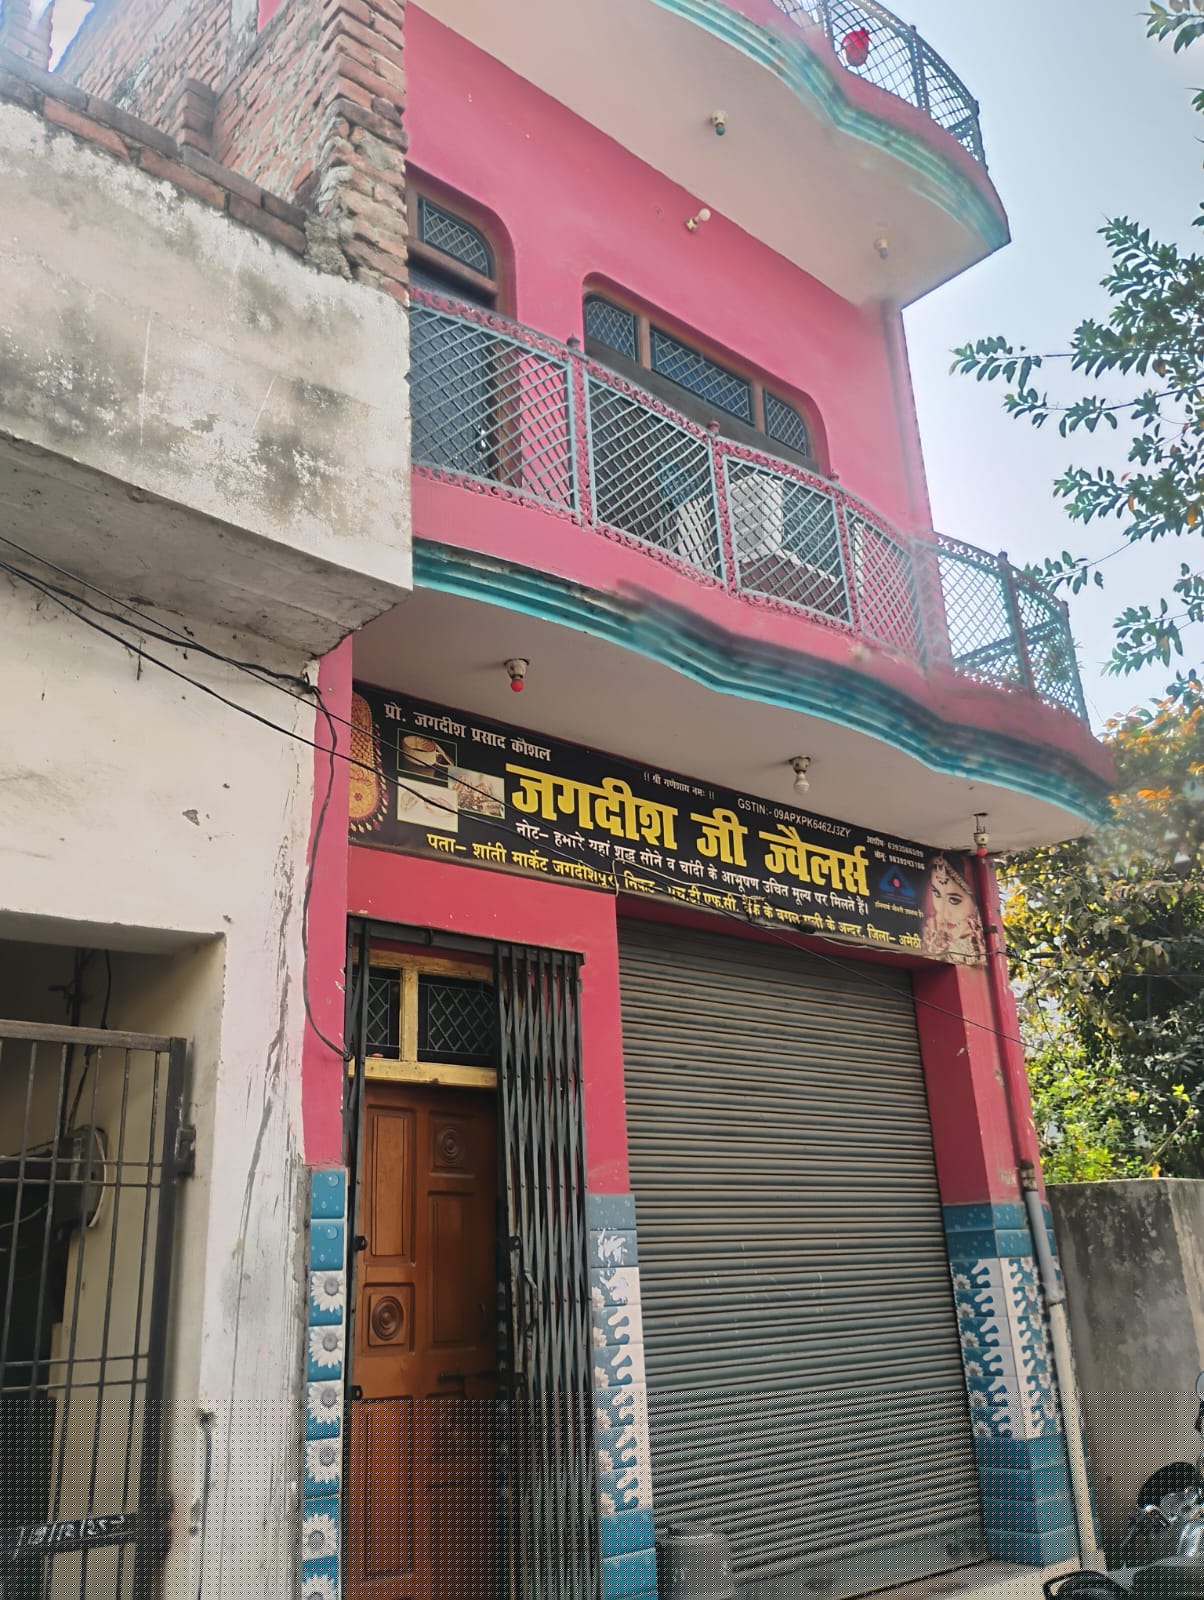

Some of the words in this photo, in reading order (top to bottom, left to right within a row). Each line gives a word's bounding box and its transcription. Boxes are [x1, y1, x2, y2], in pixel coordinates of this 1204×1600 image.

[413, 711, 466, 738] जगदीश
[471, 727, 506, 749] प्रसाद
[506, 763, 678, 850] जगदीश
[690, 808, 748, 867] जी
[759, 823, 870, 896] ज्वैलर्स
[472, 841, 506, 864] शांती
[511, 849, 548, 871] मार्केट
[763, 902, 773, 919] के
[775, 907, 800, 925] बगल
[825, 915, 836, 932] के
[898, 932, 922, 949] अमेठी
[588, 839, 610, 858] यहां
[639, 848, 663, 868] सोने
[666, 857, 675, 871] व
[679, 859, 704, 878] चांदी
[707, 863, 718, 881] के
[721, 870, 759, 893] आभूषण
[762, 877, 789, 897] उचित
[792, 887, 811, 906] मूल्य
[814, 892, 828, 907] पर
[829, 892, 856, 912] मिलते
